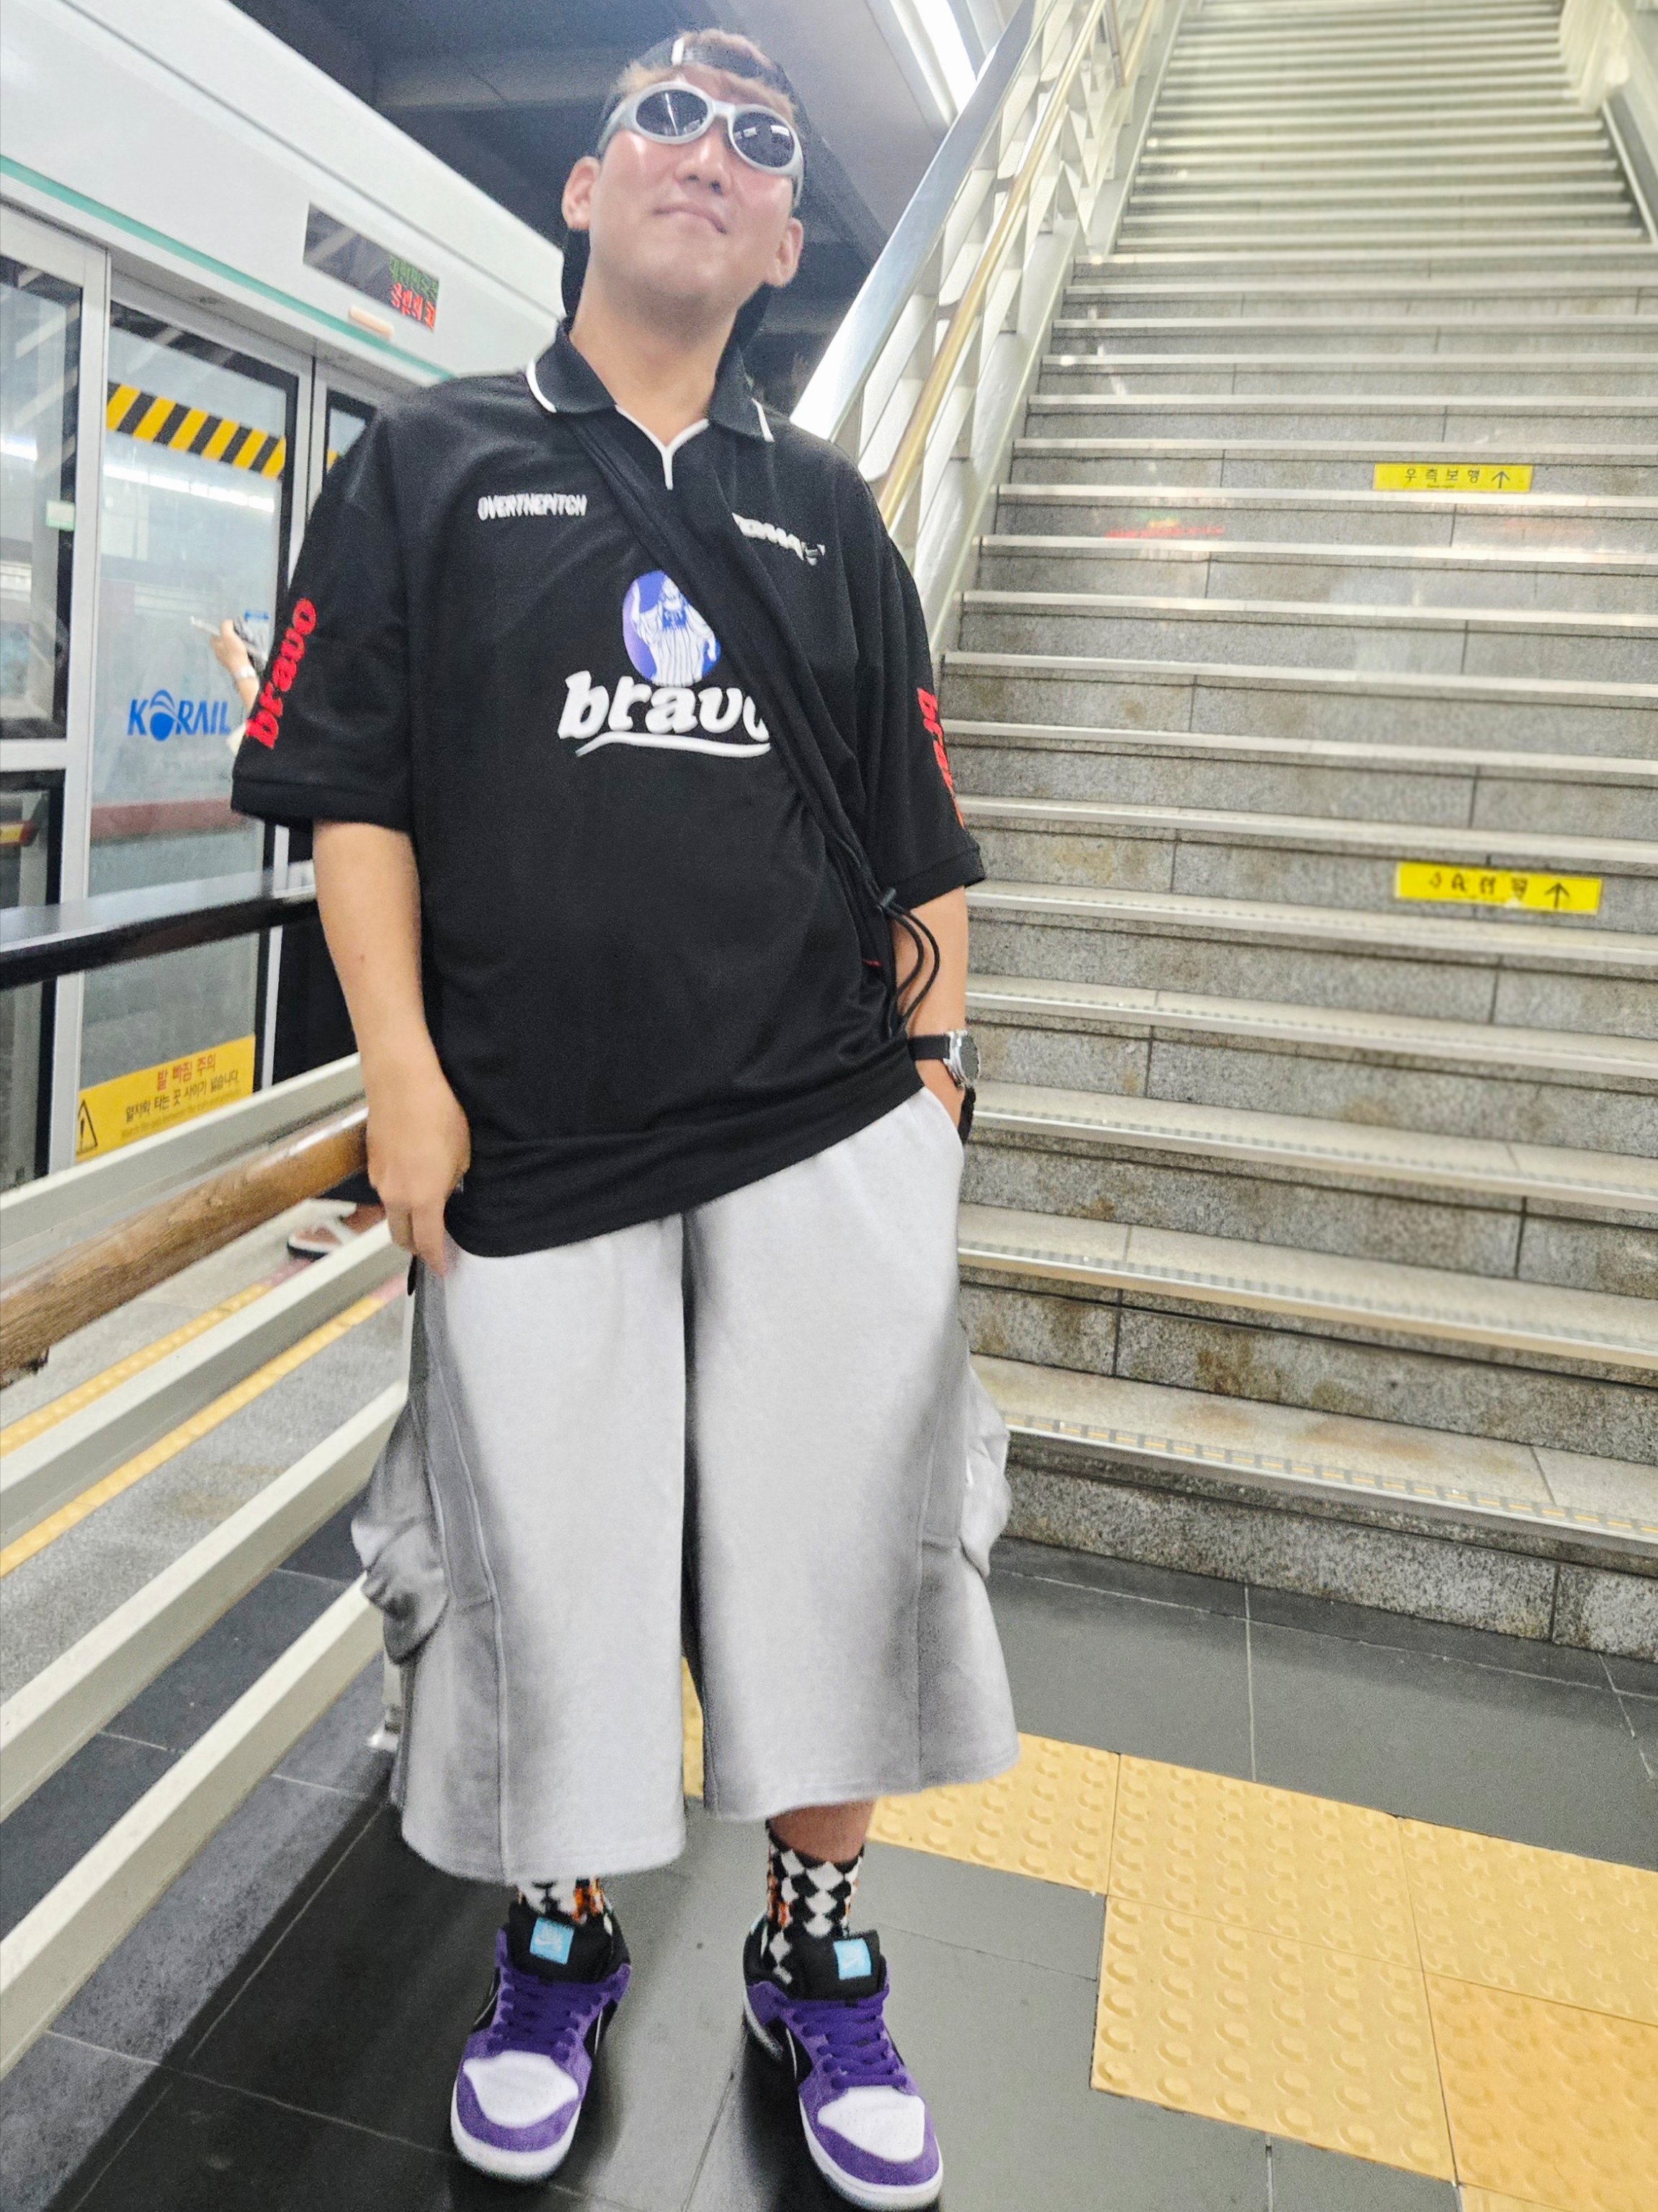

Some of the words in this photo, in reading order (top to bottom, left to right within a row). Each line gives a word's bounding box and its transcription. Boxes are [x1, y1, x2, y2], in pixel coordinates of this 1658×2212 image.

[1404, 468, 1480, 484] 우측보행
[128, 689, 231, 742] KORAIL
[157, 1068, 169, 1092] 발
[172, 1061, 193, 1084] 빠짐
[197, 1053, 216, 1077] 주의
